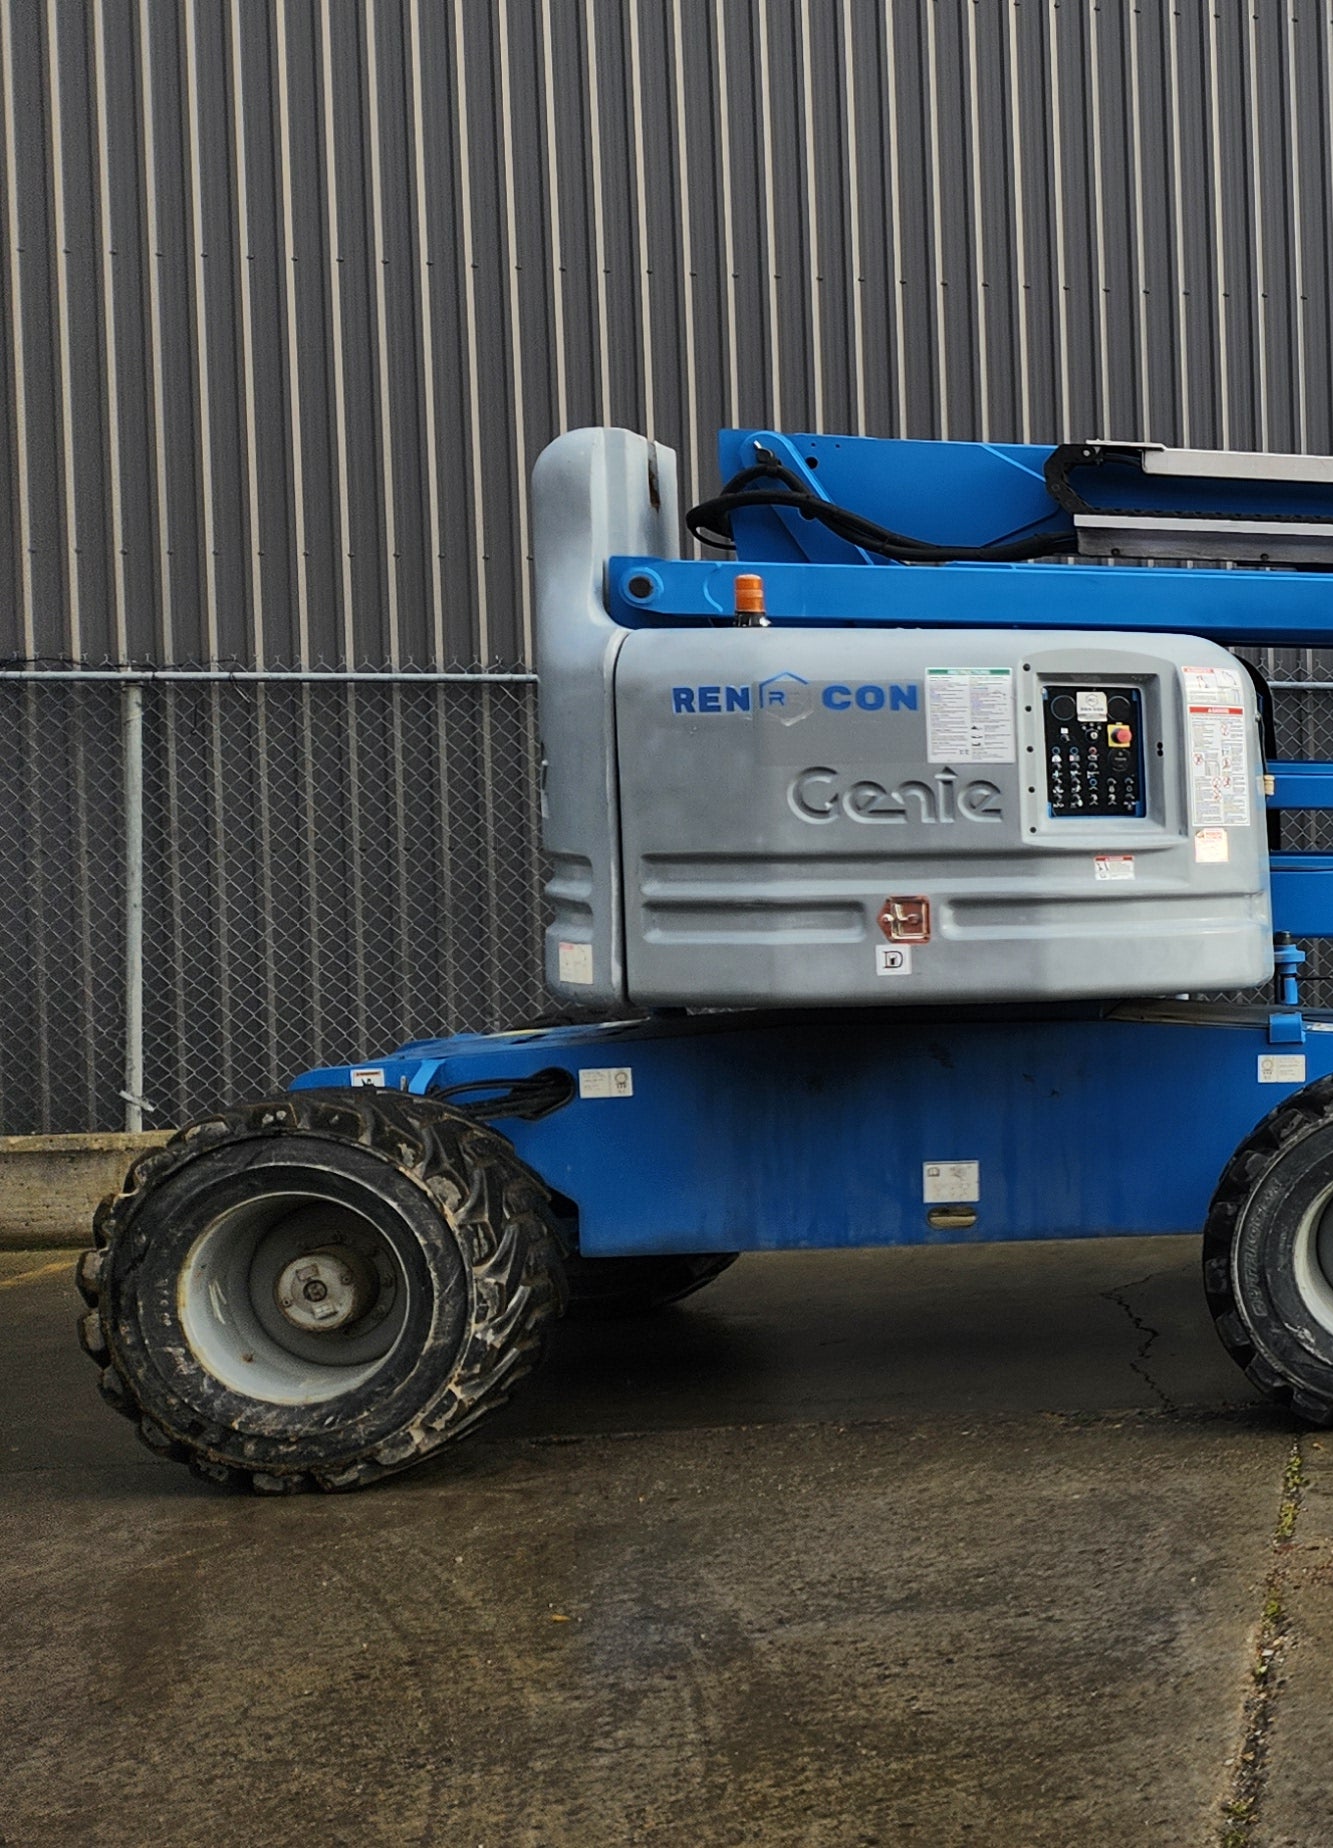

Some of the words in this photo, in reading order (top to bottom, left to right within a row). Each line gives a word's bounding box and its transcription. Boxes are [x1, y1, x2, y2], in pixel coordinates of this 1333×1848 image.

[672, 685, 750, 713] REN
[822, 684, 918, 711] CON
[787, 766, 1003, 825] Genie
